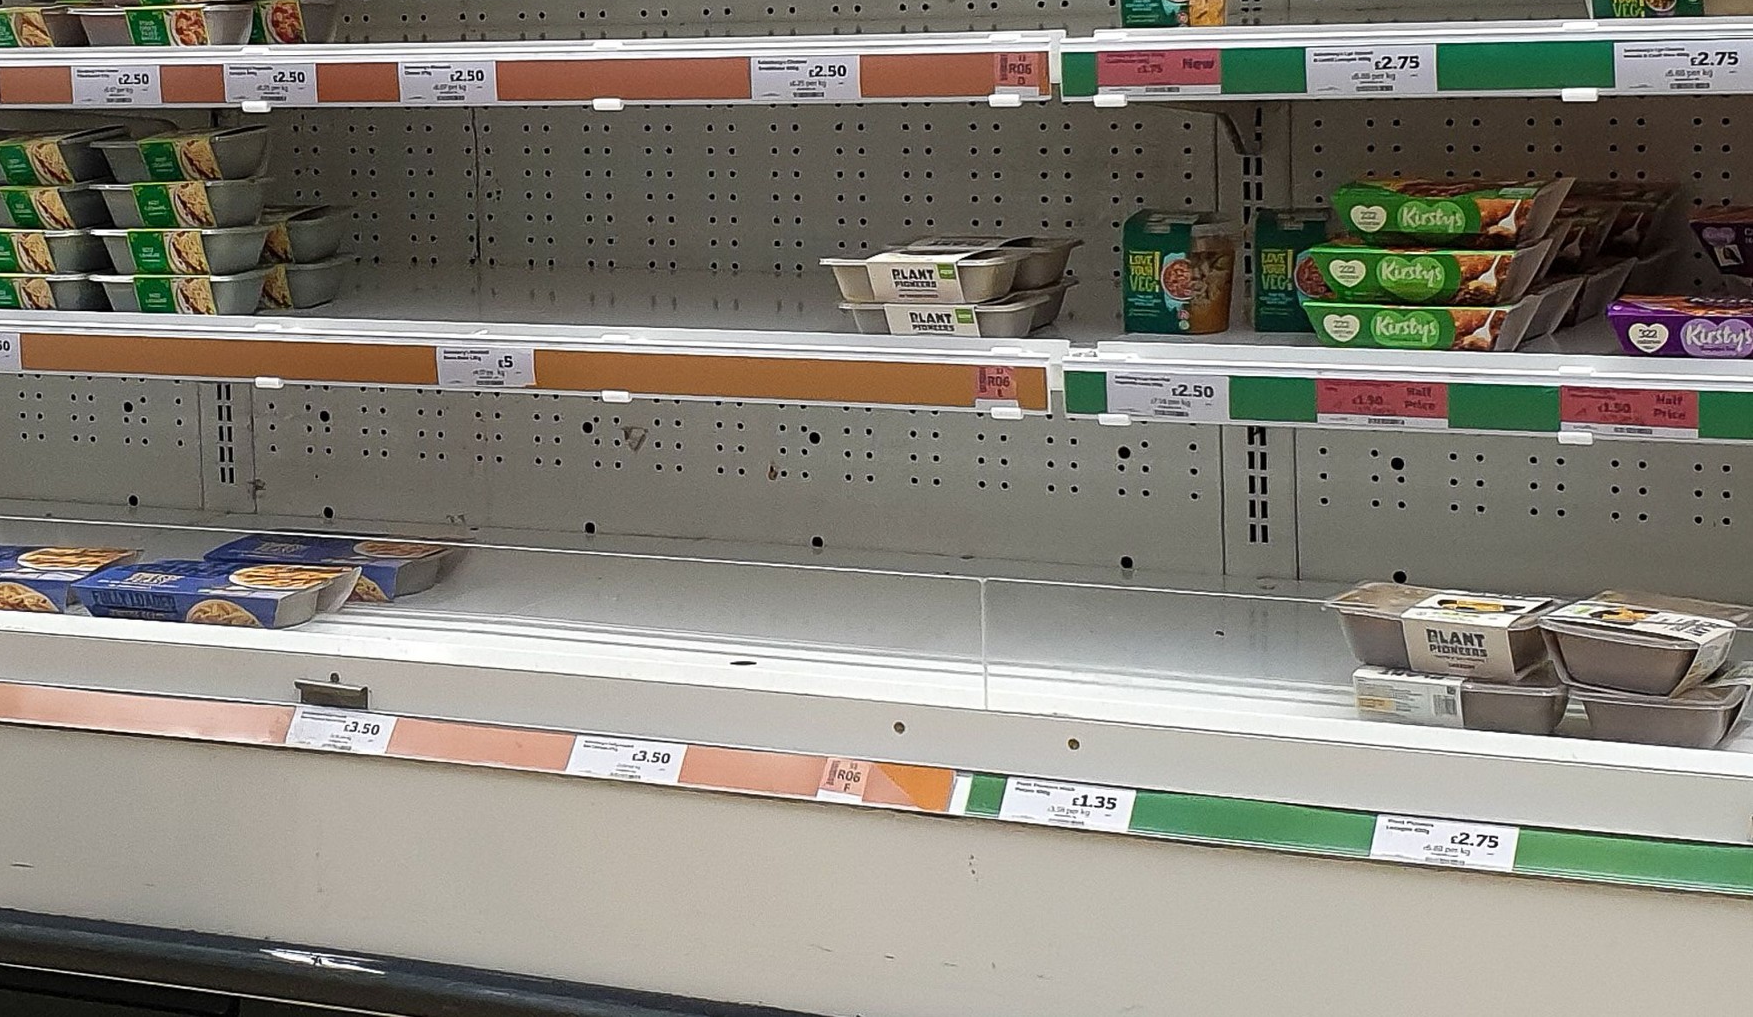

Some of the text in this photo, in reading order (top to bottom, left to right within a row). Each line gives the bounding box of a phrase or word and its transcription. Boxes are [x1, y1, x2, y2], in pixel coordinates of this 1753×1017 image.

[1182, 57, 1215, 70] New
[1375, 56, 1420, 70] £2.75
[1690, 51, 1739, 67] £2.75
[808, 65, 847, 78] £2.50
[1009, 63, 1032, 74] R06
[118, 74, 150, 85] £2.50
[273, 72, 306, 83] £2.50
[450, 70, 485, 82] £2.50
[1403, 206, 1463, 233] Kirsty's
[1128, 253, 1153, 265] LOVE
[1261, 251, 1287, 264] LOVE
[891, 268, 935, 281] PLANT
[1129, 265, 1154, 276] YOUR
[1381, 260, 1443, 287] Kirsty's
[908, 311, 953, 324] PLANT
[1375, 315, 1437, 343] Kirsty's
[1685, 324, 1753, 353] Kirsty's
[498, 356, 513, 368] £5
[988, 376, 1011, 387] R06
[1171, 385, 1214, 399] £2.50
[1655, 394, 1684, 406] Half
[1653, 408, 1686, 421] Price
[1426, 628, 1486, 648] PLANT
[344, 721, 381, 736] £3.50
[632, 750, 671, 764] £3.50
[837, 767, 862, 783] R06
[1072, 794, 1118, 811] £1.35
[1451, 832, 1499, 849] £2.75
